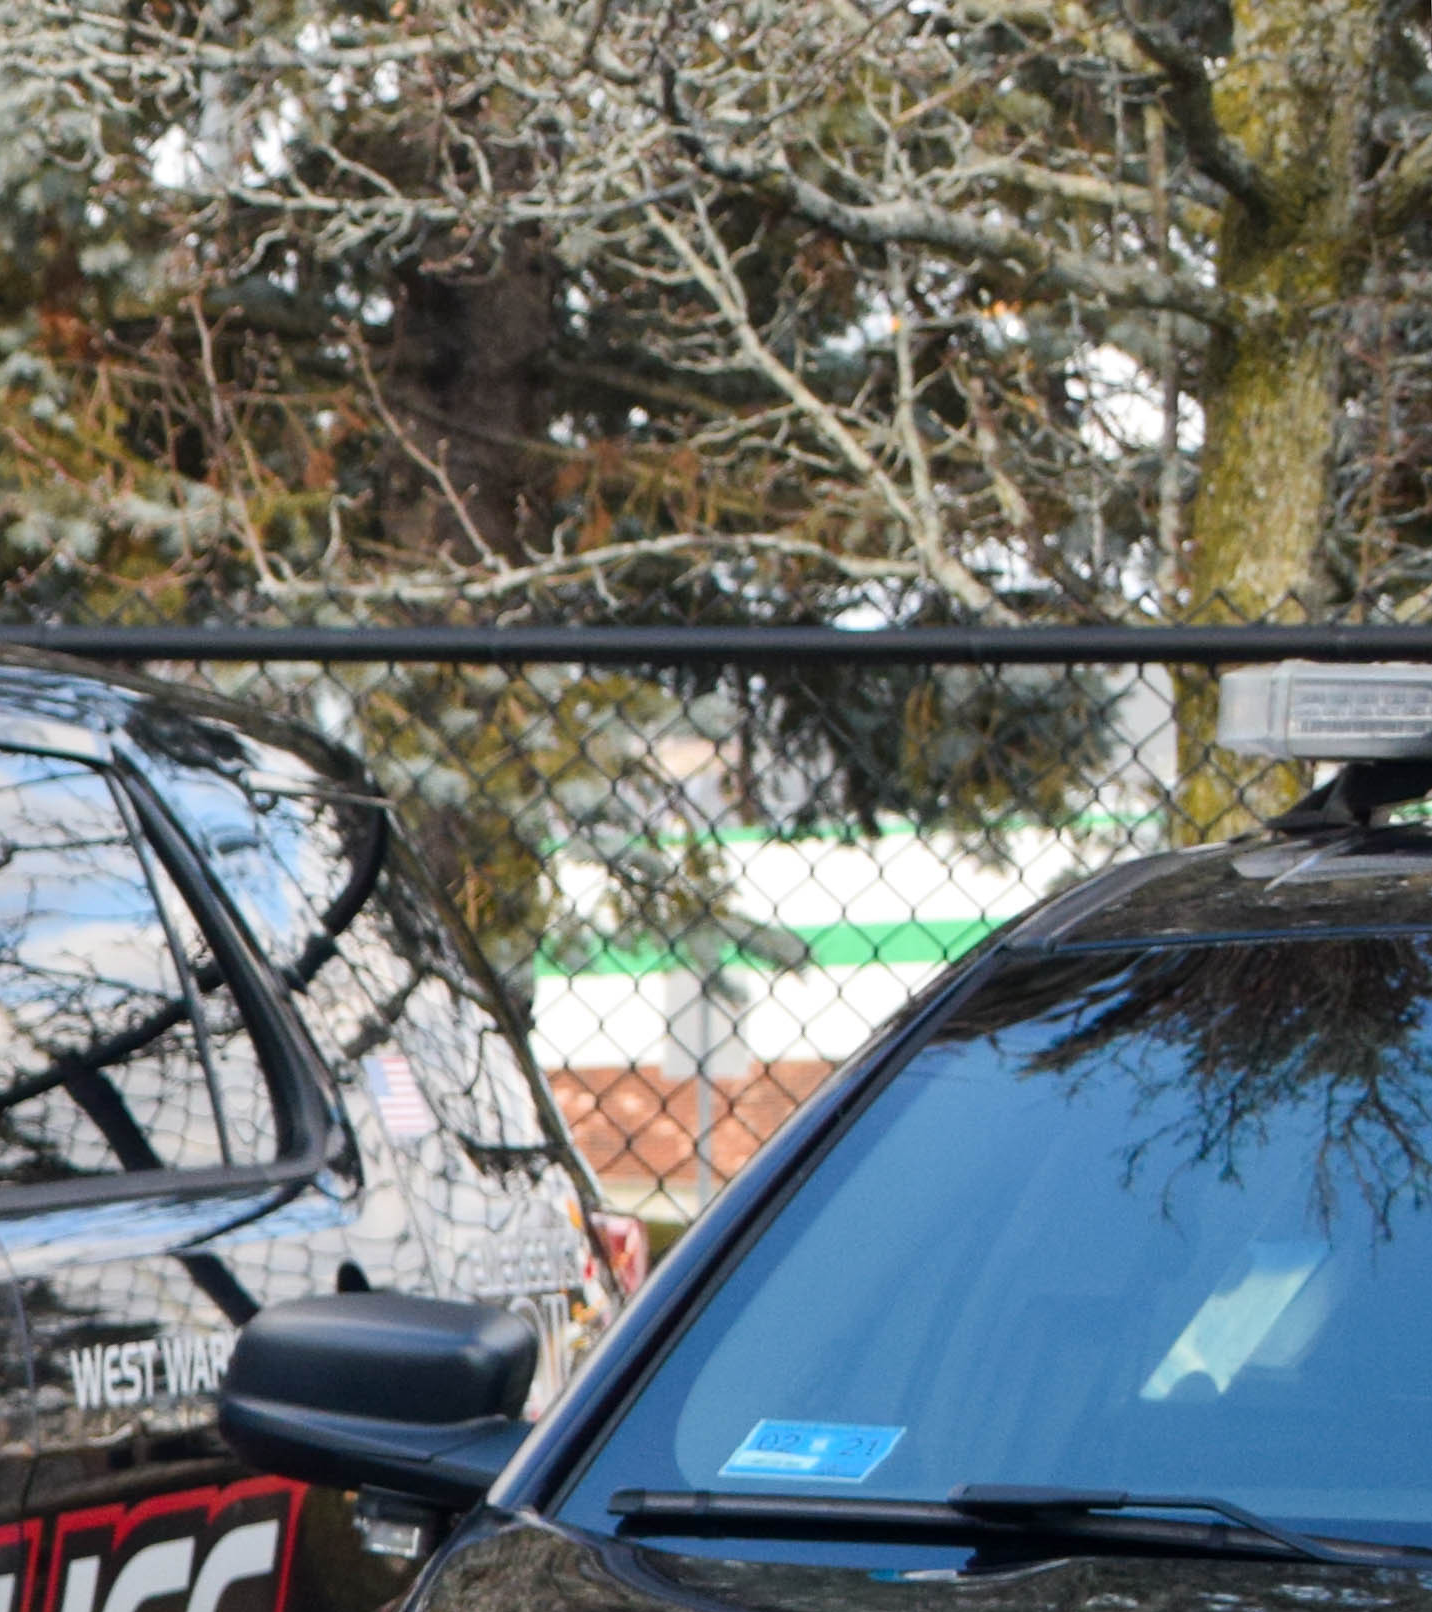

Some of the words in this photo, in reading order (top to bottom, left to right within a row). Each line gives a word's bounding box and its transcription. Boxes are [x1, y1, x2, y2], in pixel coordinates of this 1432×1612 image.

[70, 1339, 157, 1411] WEST
[161, 1328, 241, 1397] WAR
[757, 1430, 802, 1454] 02
